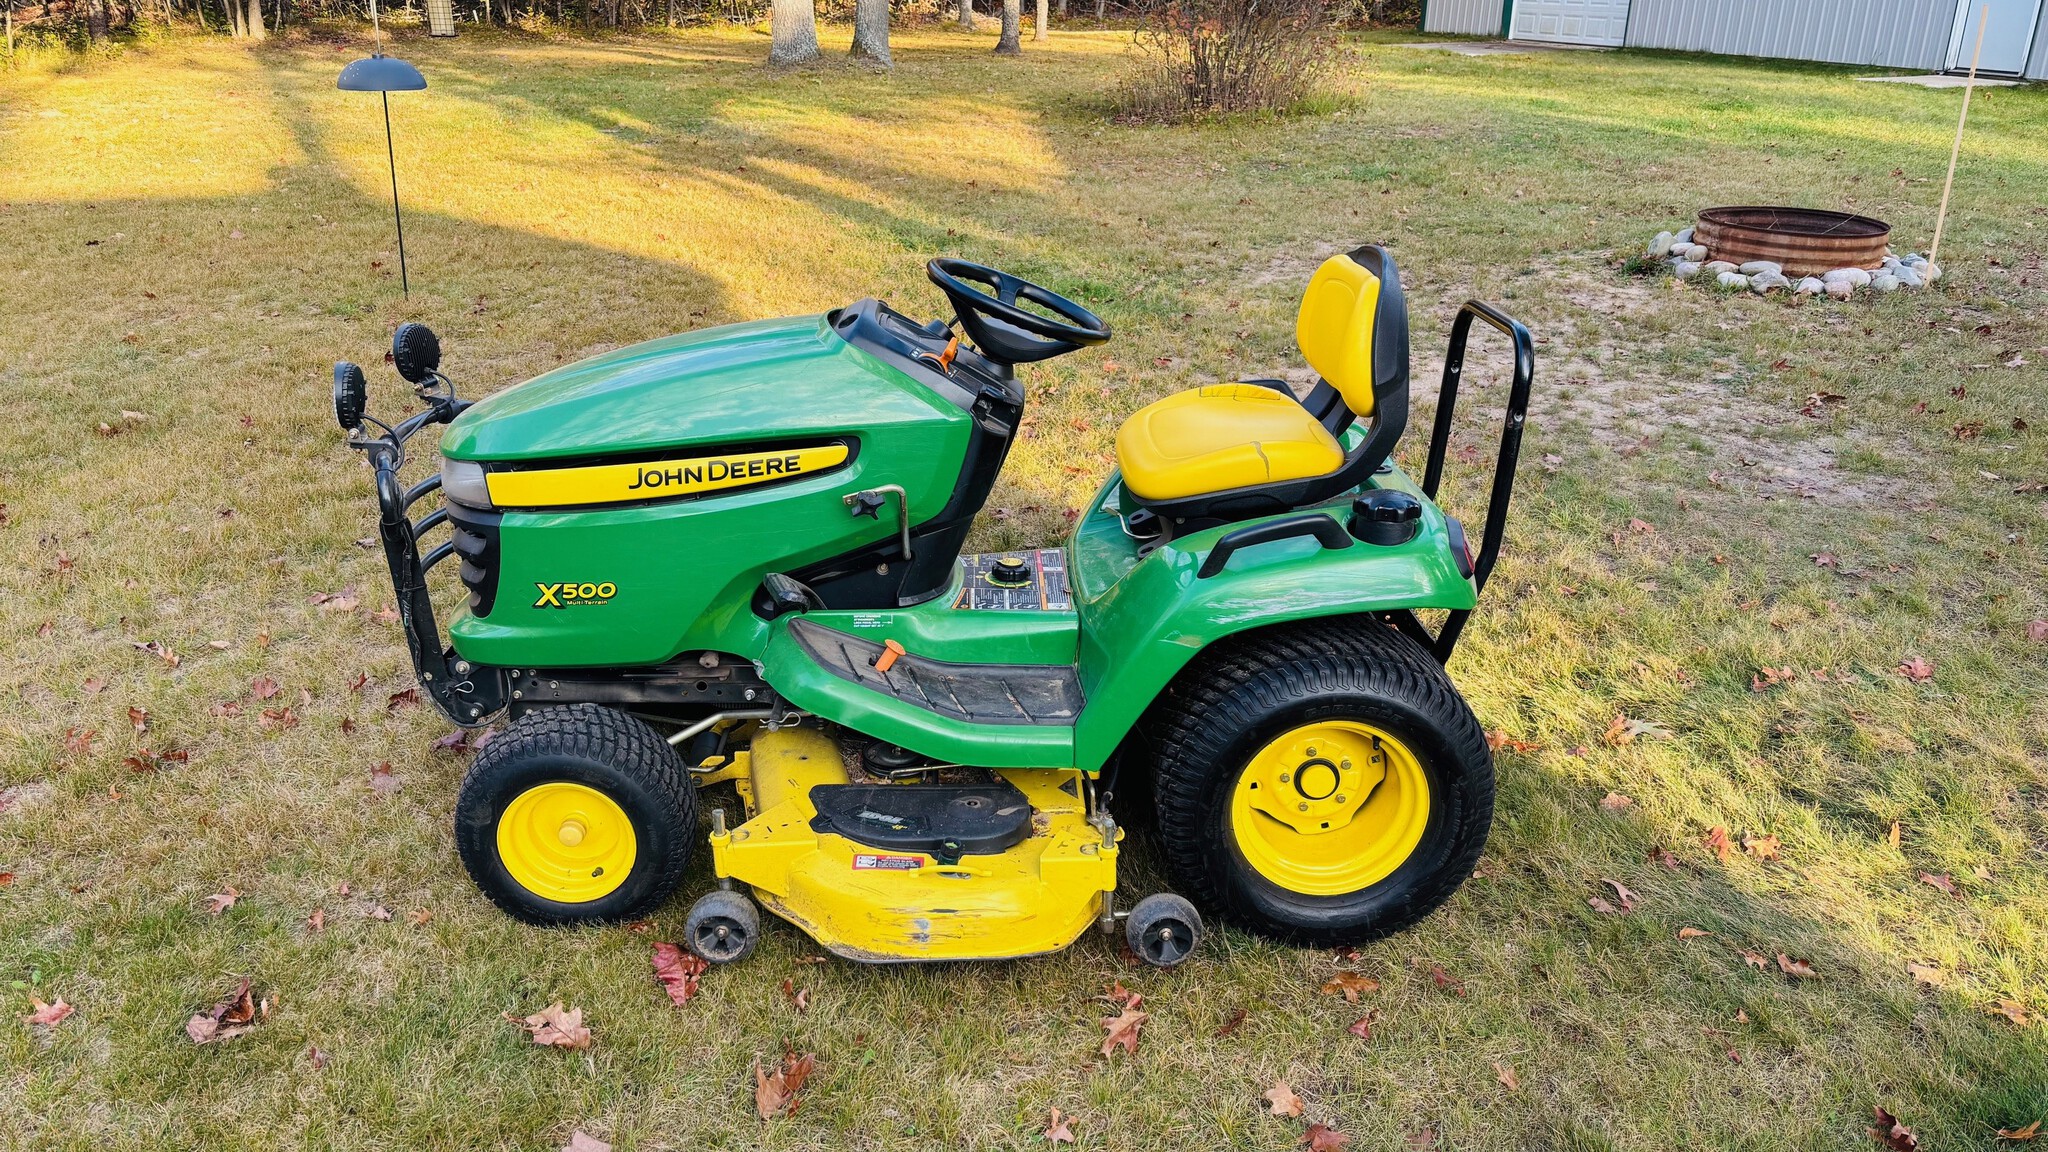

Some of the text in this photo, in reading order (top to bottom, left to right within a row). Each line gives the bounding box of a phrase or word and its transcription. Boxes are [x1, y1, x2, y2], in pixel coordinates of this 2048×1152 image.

[628, 455, 801, 489] JOHN DEERE
[533, 582, 617, 607] X500
